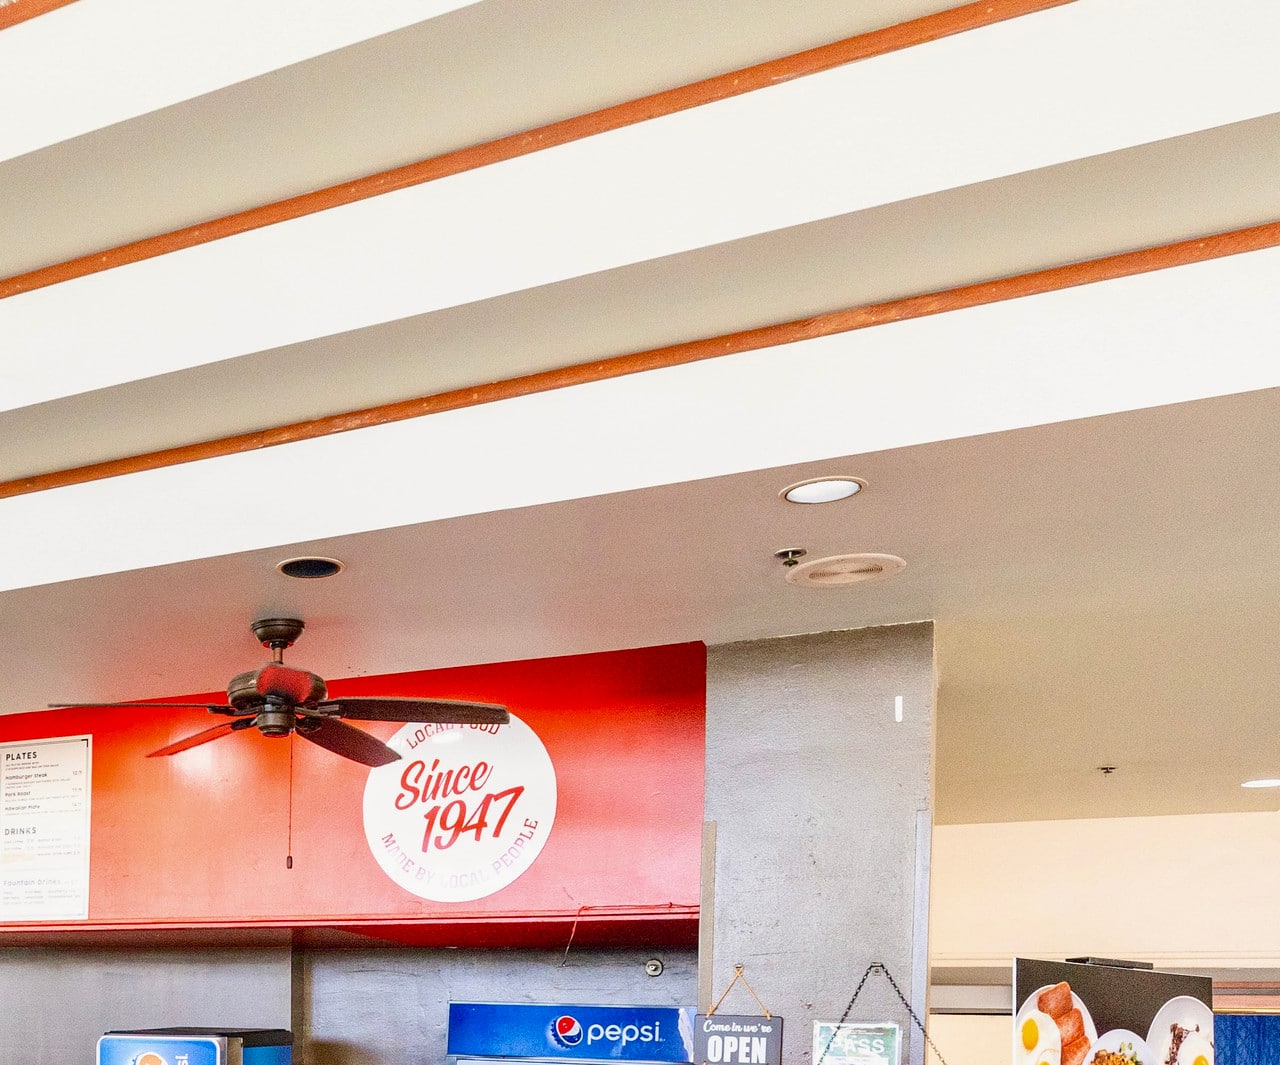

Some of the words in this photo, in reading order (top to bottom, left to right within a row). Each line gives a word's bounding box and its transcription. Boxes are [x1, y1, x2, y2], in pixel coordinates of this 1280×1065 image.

[5, 752, 37, 760] PLATES
[395, 759, 493, 810] Since
[4, 827, 37, 836] DRINKS
[422, 786, 525, 853] 1947
[492, 818, 538, 875] PEOPLE
[587, 1021, 661, 1046] pepsi
[703, 1020, 731, 1033] Come
[732, 1022, 742, 1032] in
[707, 1035, 767, 1064] OPEN
